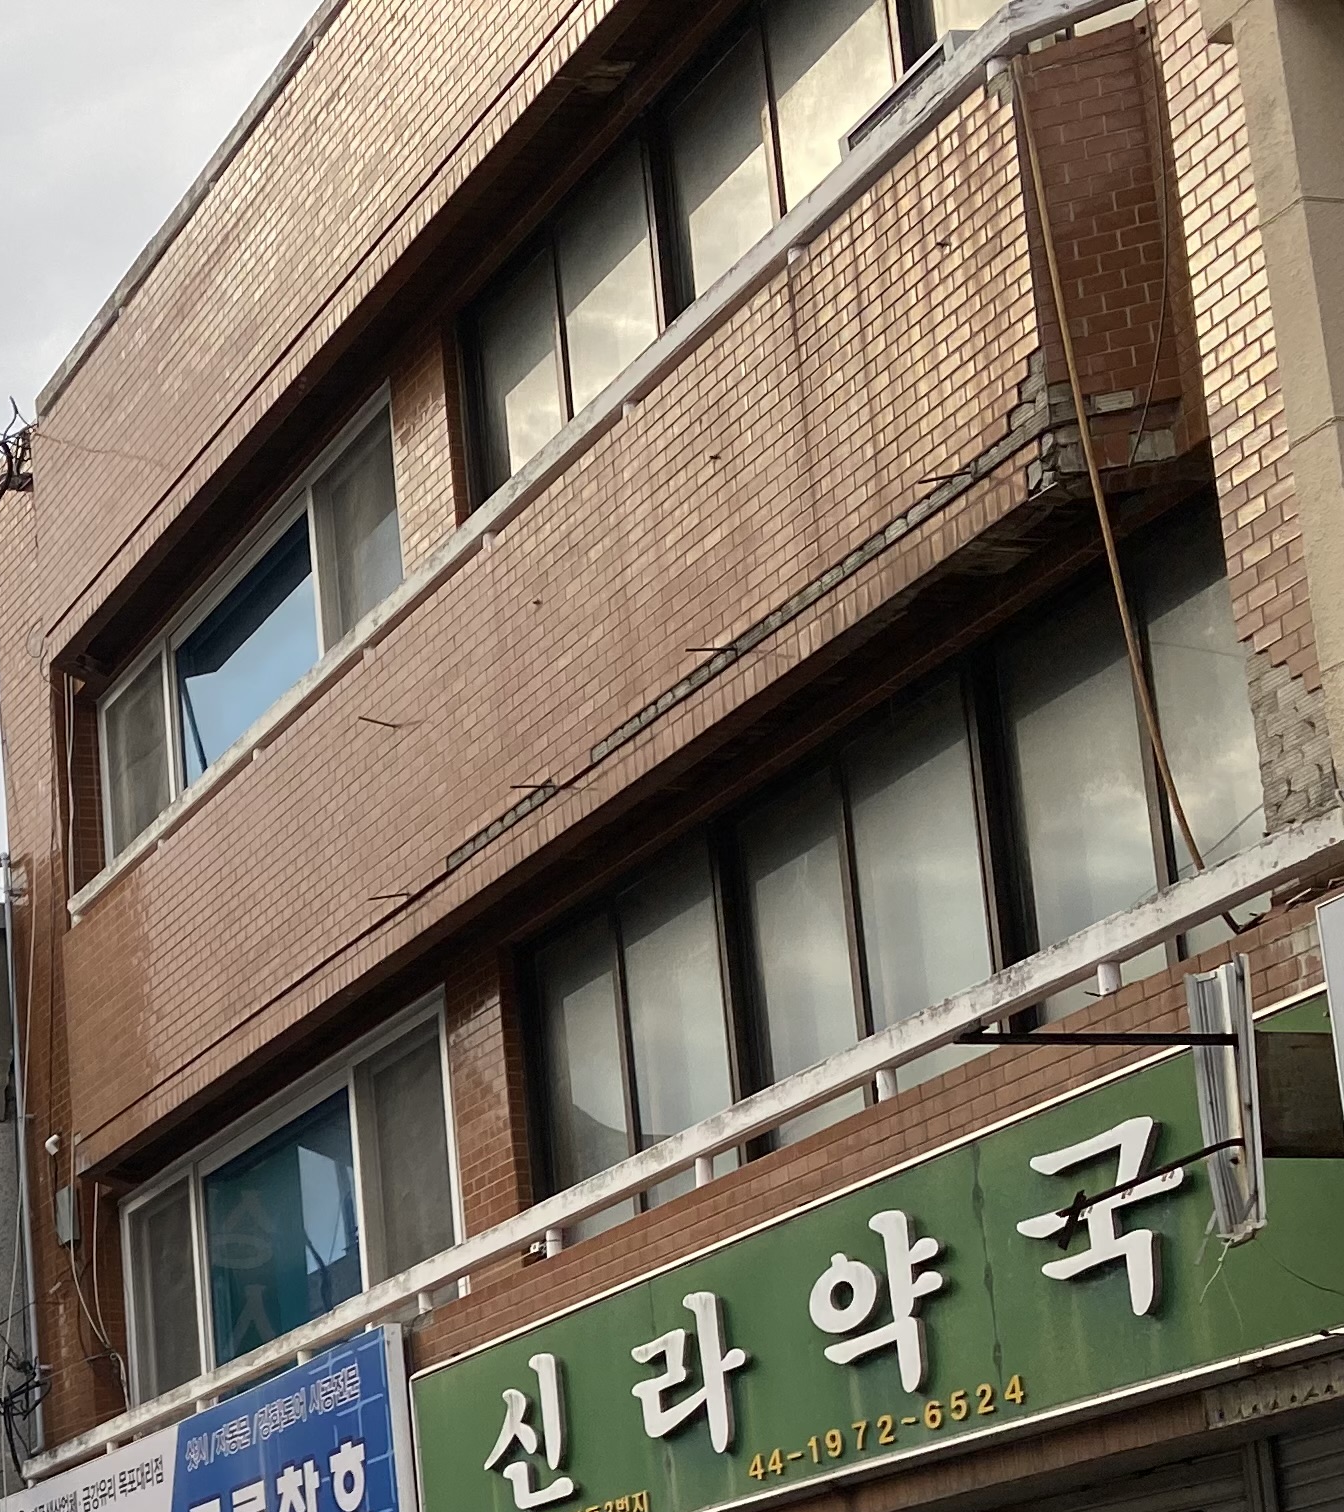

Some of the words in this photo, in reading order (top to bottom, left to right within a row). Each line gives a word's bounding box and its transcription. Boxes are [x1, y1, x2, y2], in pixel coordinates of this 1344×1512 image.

[483, 1114, 1185, 1512] 신라약국
[118, 1454, 164, 1498] 목포대리점
[747, 1374, 1026, 1482] 44-1972-6524
